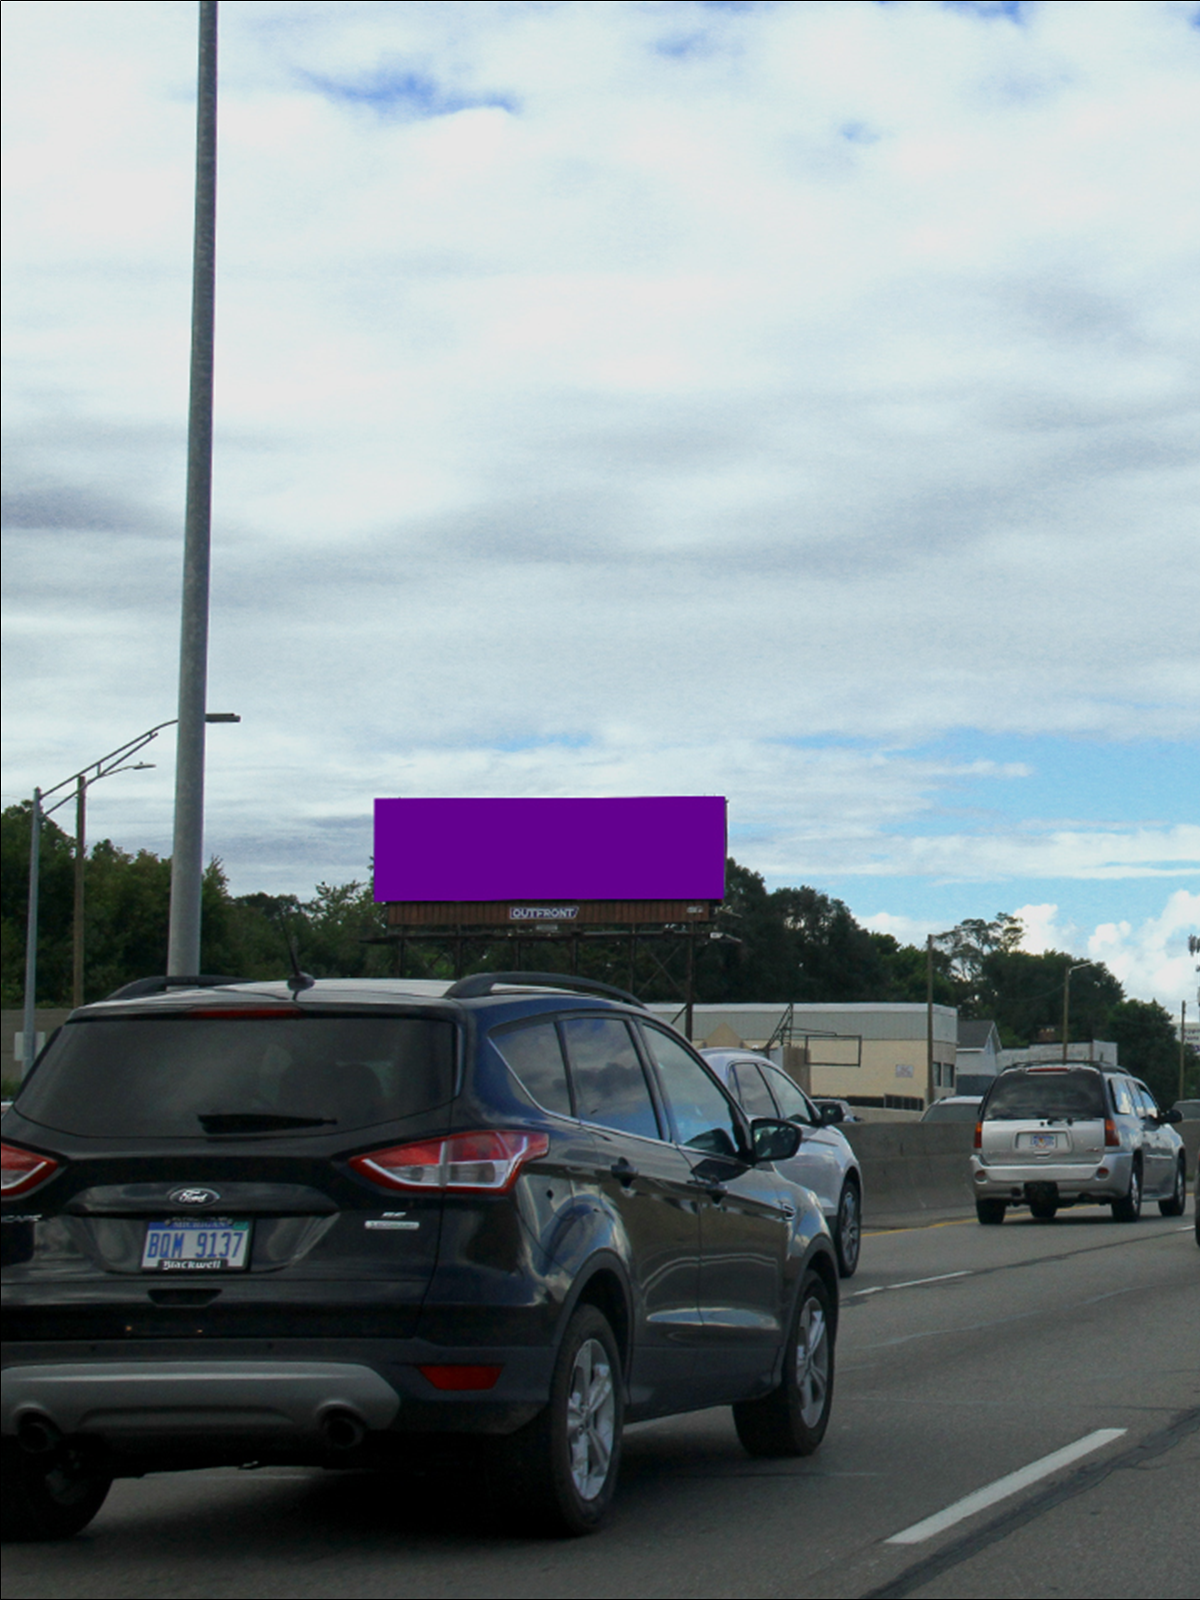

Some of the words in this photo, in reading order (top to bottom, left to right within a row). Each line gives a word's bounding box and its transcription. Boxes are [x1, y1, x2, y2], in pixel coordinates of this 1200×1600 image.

[512, 907, 575, 918] OUTFRONT
[179, 1189, 208, 1203] Ford
[147, 1232, 185, 1258] BQM
[195, 1232, 243, 1258] 9137
[162, 1260, 222, 1270] Blackwell
